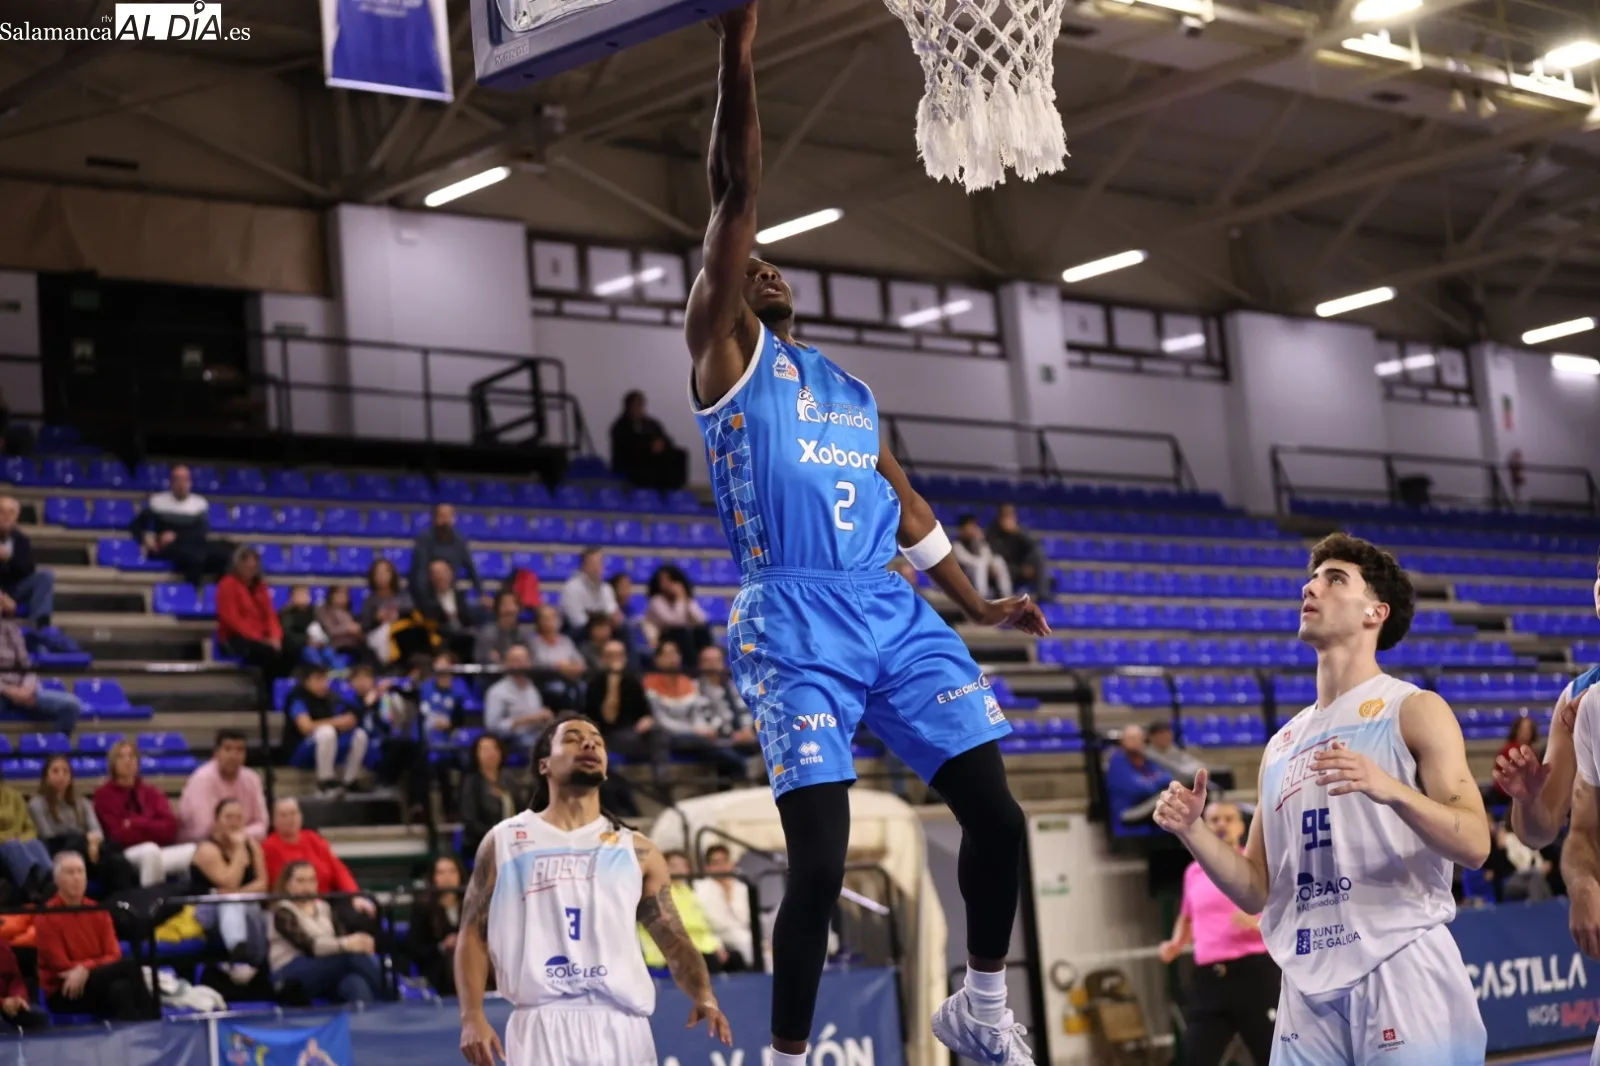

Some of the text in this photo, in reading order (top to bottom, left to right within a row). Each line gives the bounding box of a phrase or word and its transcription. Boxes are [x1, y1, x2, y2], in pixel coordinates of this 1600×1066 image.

[834, 481, 856, 531] 2
[1302, 807, 1332, 851] 95
[565, 907, 581, 941] 3
[1313, 924, 1345, 938] XUNTA
[1312, 940, 1325, 951] DE
